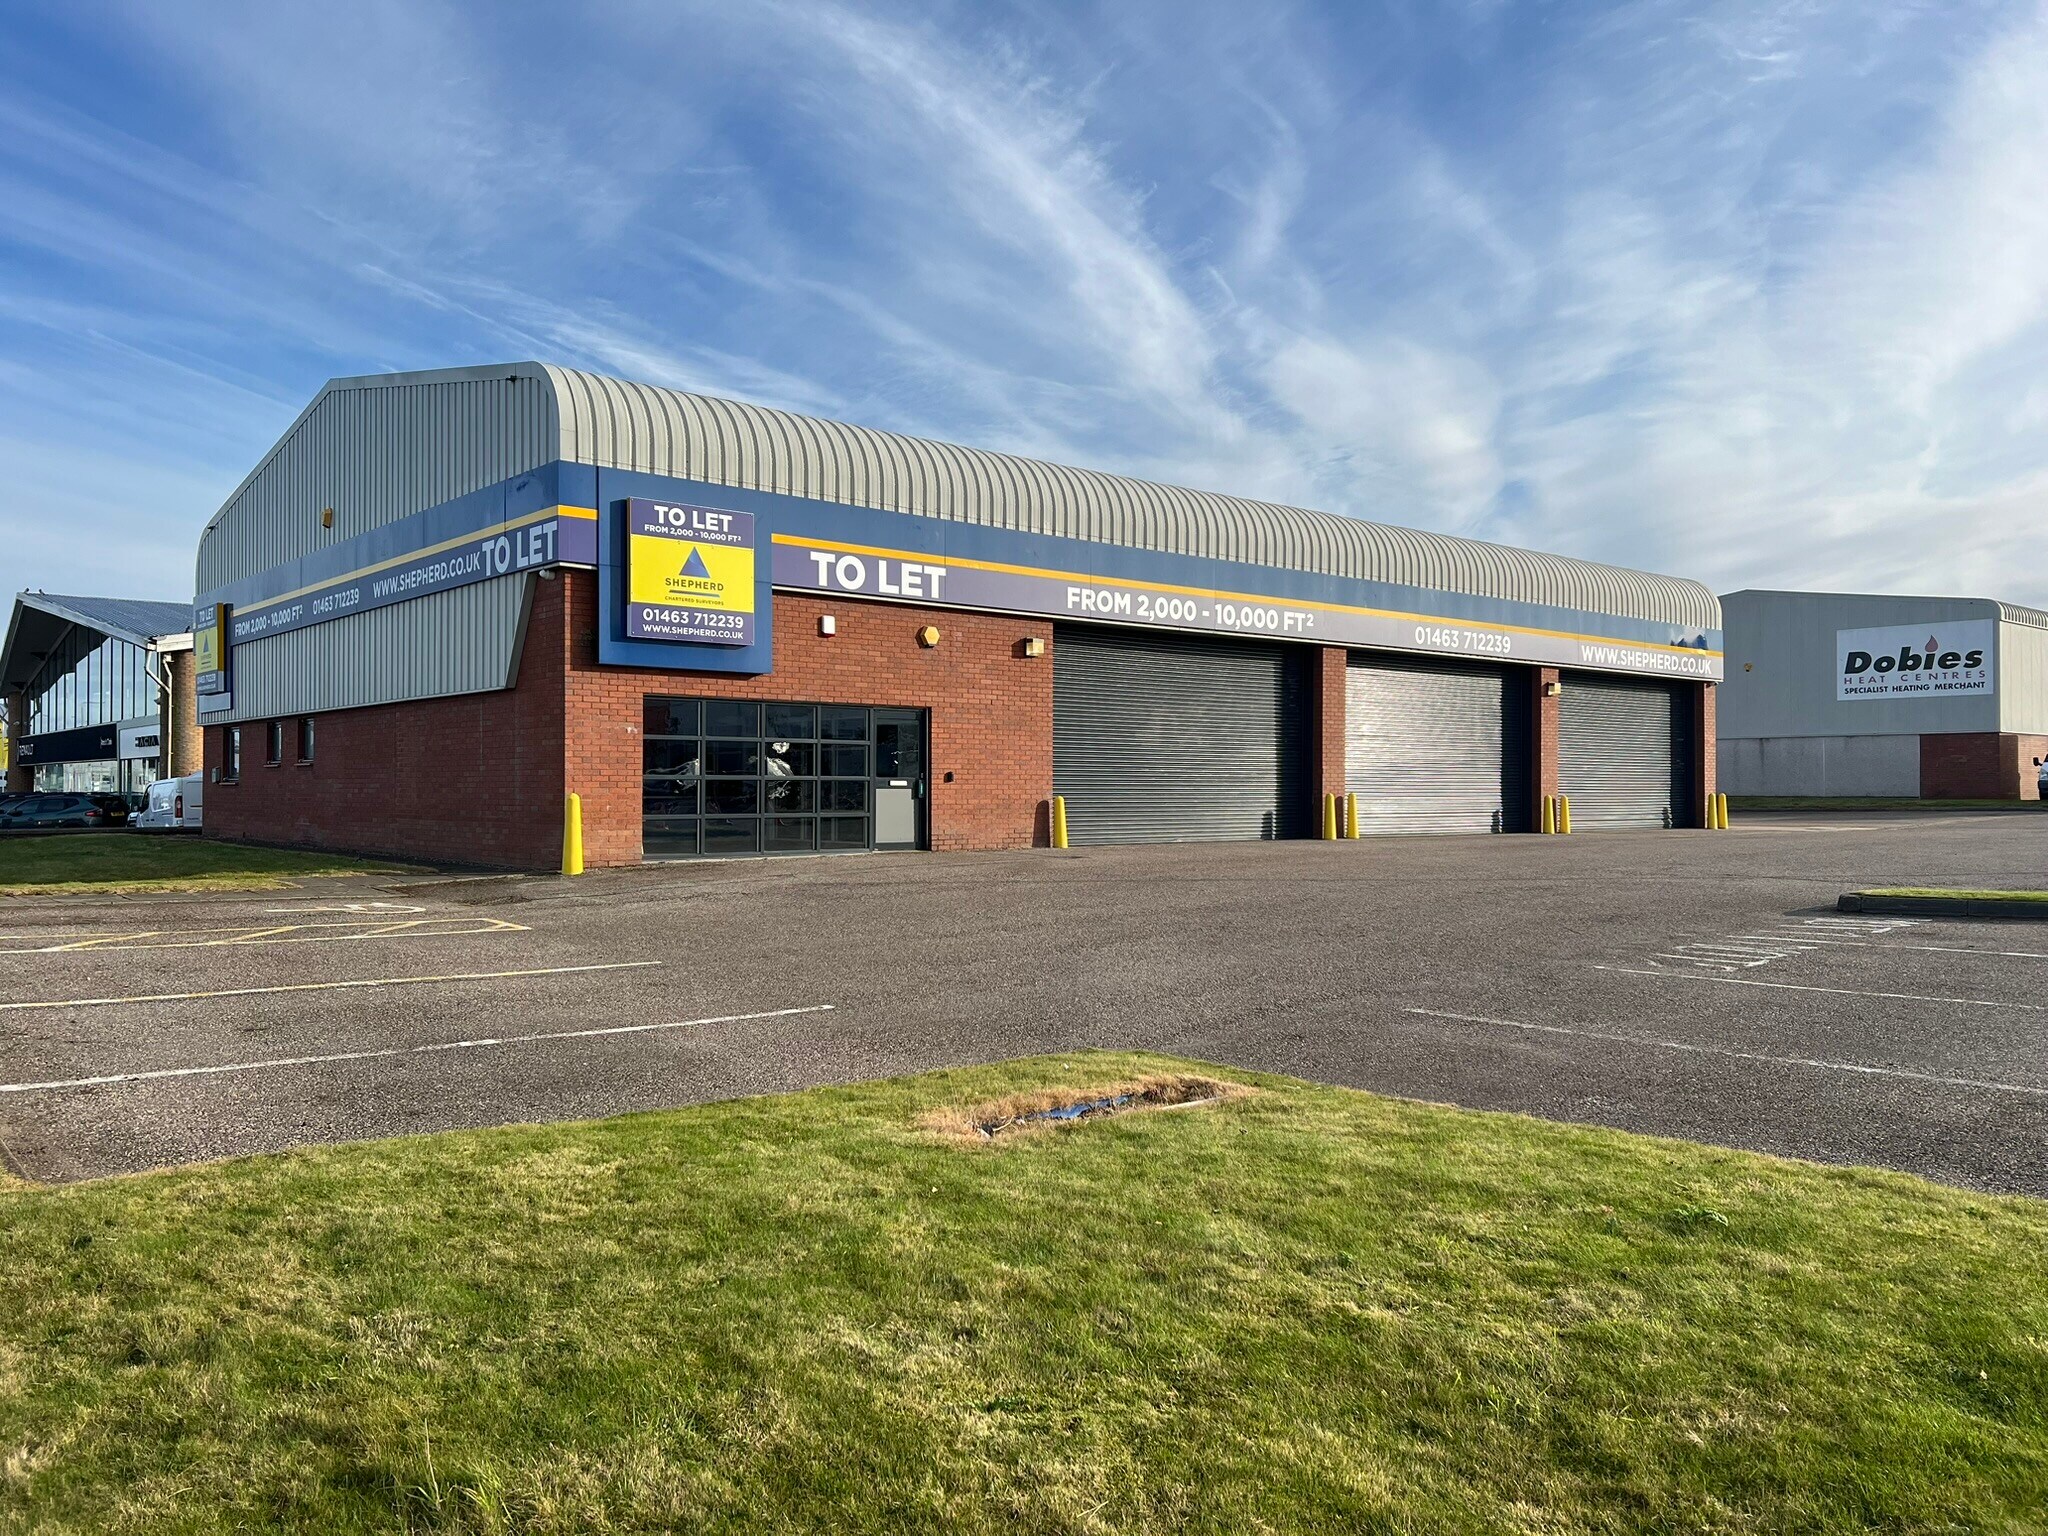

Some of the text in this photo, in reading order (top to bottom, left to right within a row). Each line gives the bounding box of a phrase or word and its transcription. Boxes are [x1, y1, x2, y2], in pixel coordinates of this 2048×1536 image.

[644, 524, 669, 534] FROM
[670, 528, 694, 537] 2,000
[700, 531, 727, 541] 10,000
[653, 505, 733, 533] TO LET
[482, 520, 558, 577] TO LET
[373, 552, 480, 598] WWW.SHEPHERD.CO.UK
[665, 577, 724, 592] SHEPHERD
[810, 551, 947, 599] TO LET
[312, 588, 360, 615] 01463 712239
[665, 595, 695, 604] CHARTERED
[1067, 586, 1131, 615] FROM
[1136, 595, 1197, 622] 2,000
[1214, 604, 1279, 631] 10,000
[234, 621, 251, 638] FROM
[250, 616, 267, 635] 2,000
[271, 611, 292, 628] 10,000
[642, 608, 744, 629] 01463 712239
[642, 623, 744, 640] WWW.SHEPHERD.CO.UK
[1415, 626, 1511, 655] 01463 712239
[1581, 645, 1712, 675] WWW.SHEPHERD.CO.UK
[1844, 646, 1984, 675] Dobies
[1844, 670, 1986, 685] HEAT CENTRES
[1844, 681, 1986, 695] SPECIALIST HEATING MERCHANT
